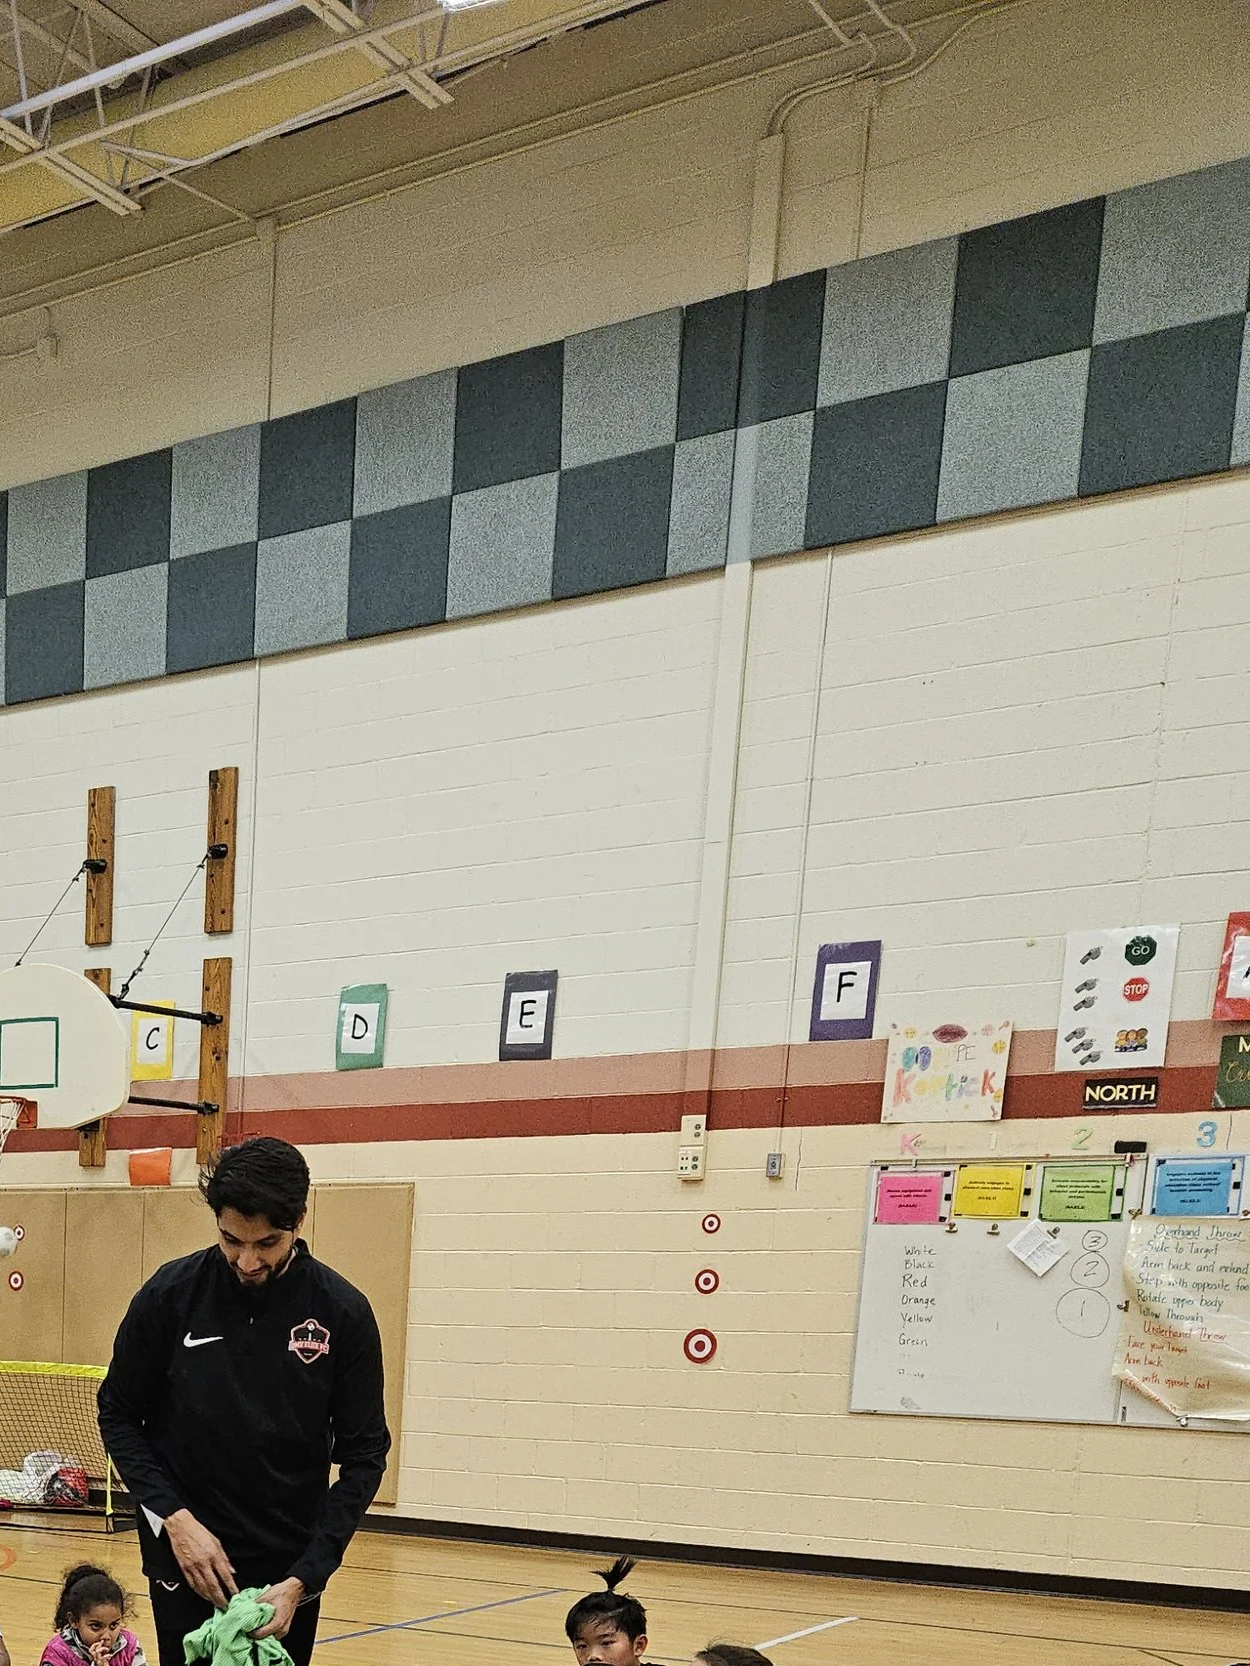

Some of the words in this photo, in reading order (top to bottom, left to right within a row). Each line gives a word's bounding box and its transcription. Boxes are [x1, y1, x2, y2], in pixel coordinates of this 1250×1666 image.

[1131, 945, 1151, 956] GO
[836, 970, 857, 1003] F
[1124, 983, 1149, 996] STOP
[519, 999, 537, 1028] E
[351, 1013, 368, 1040] D
[145, 1026, 160, 1050] C
[956, 1043, 976, 1062] PE
[1085, 1083, 1157, 1102] NORTH
[900, 1131, 922, 1156] K
[989, 1129, 998, 1151] 1
[1072, 1127, 1093, 1151] 2
[1196, 1121, 1219, 1148] 3
[1088, 1236, 1102, 1248] 3
[1175, 1242, 1184, 1254] to
[1186, 1242, 1219, 1259] Target
[1083, 1260, 1100, 1277] 2
[1168, 1258, 1191, 1271] back
[1196, 1261, 1216, 1273] and
[902, 1272, 928, 1288] Red
[1191, 1279, 1230, 1292] opposite
[901, 1294, 936, 1309] Orange
[1199, 1295, 1224, 1313] body
[900, 1312, 933, 1328] Yellow
[898, 1332, 928, 1347] Green
